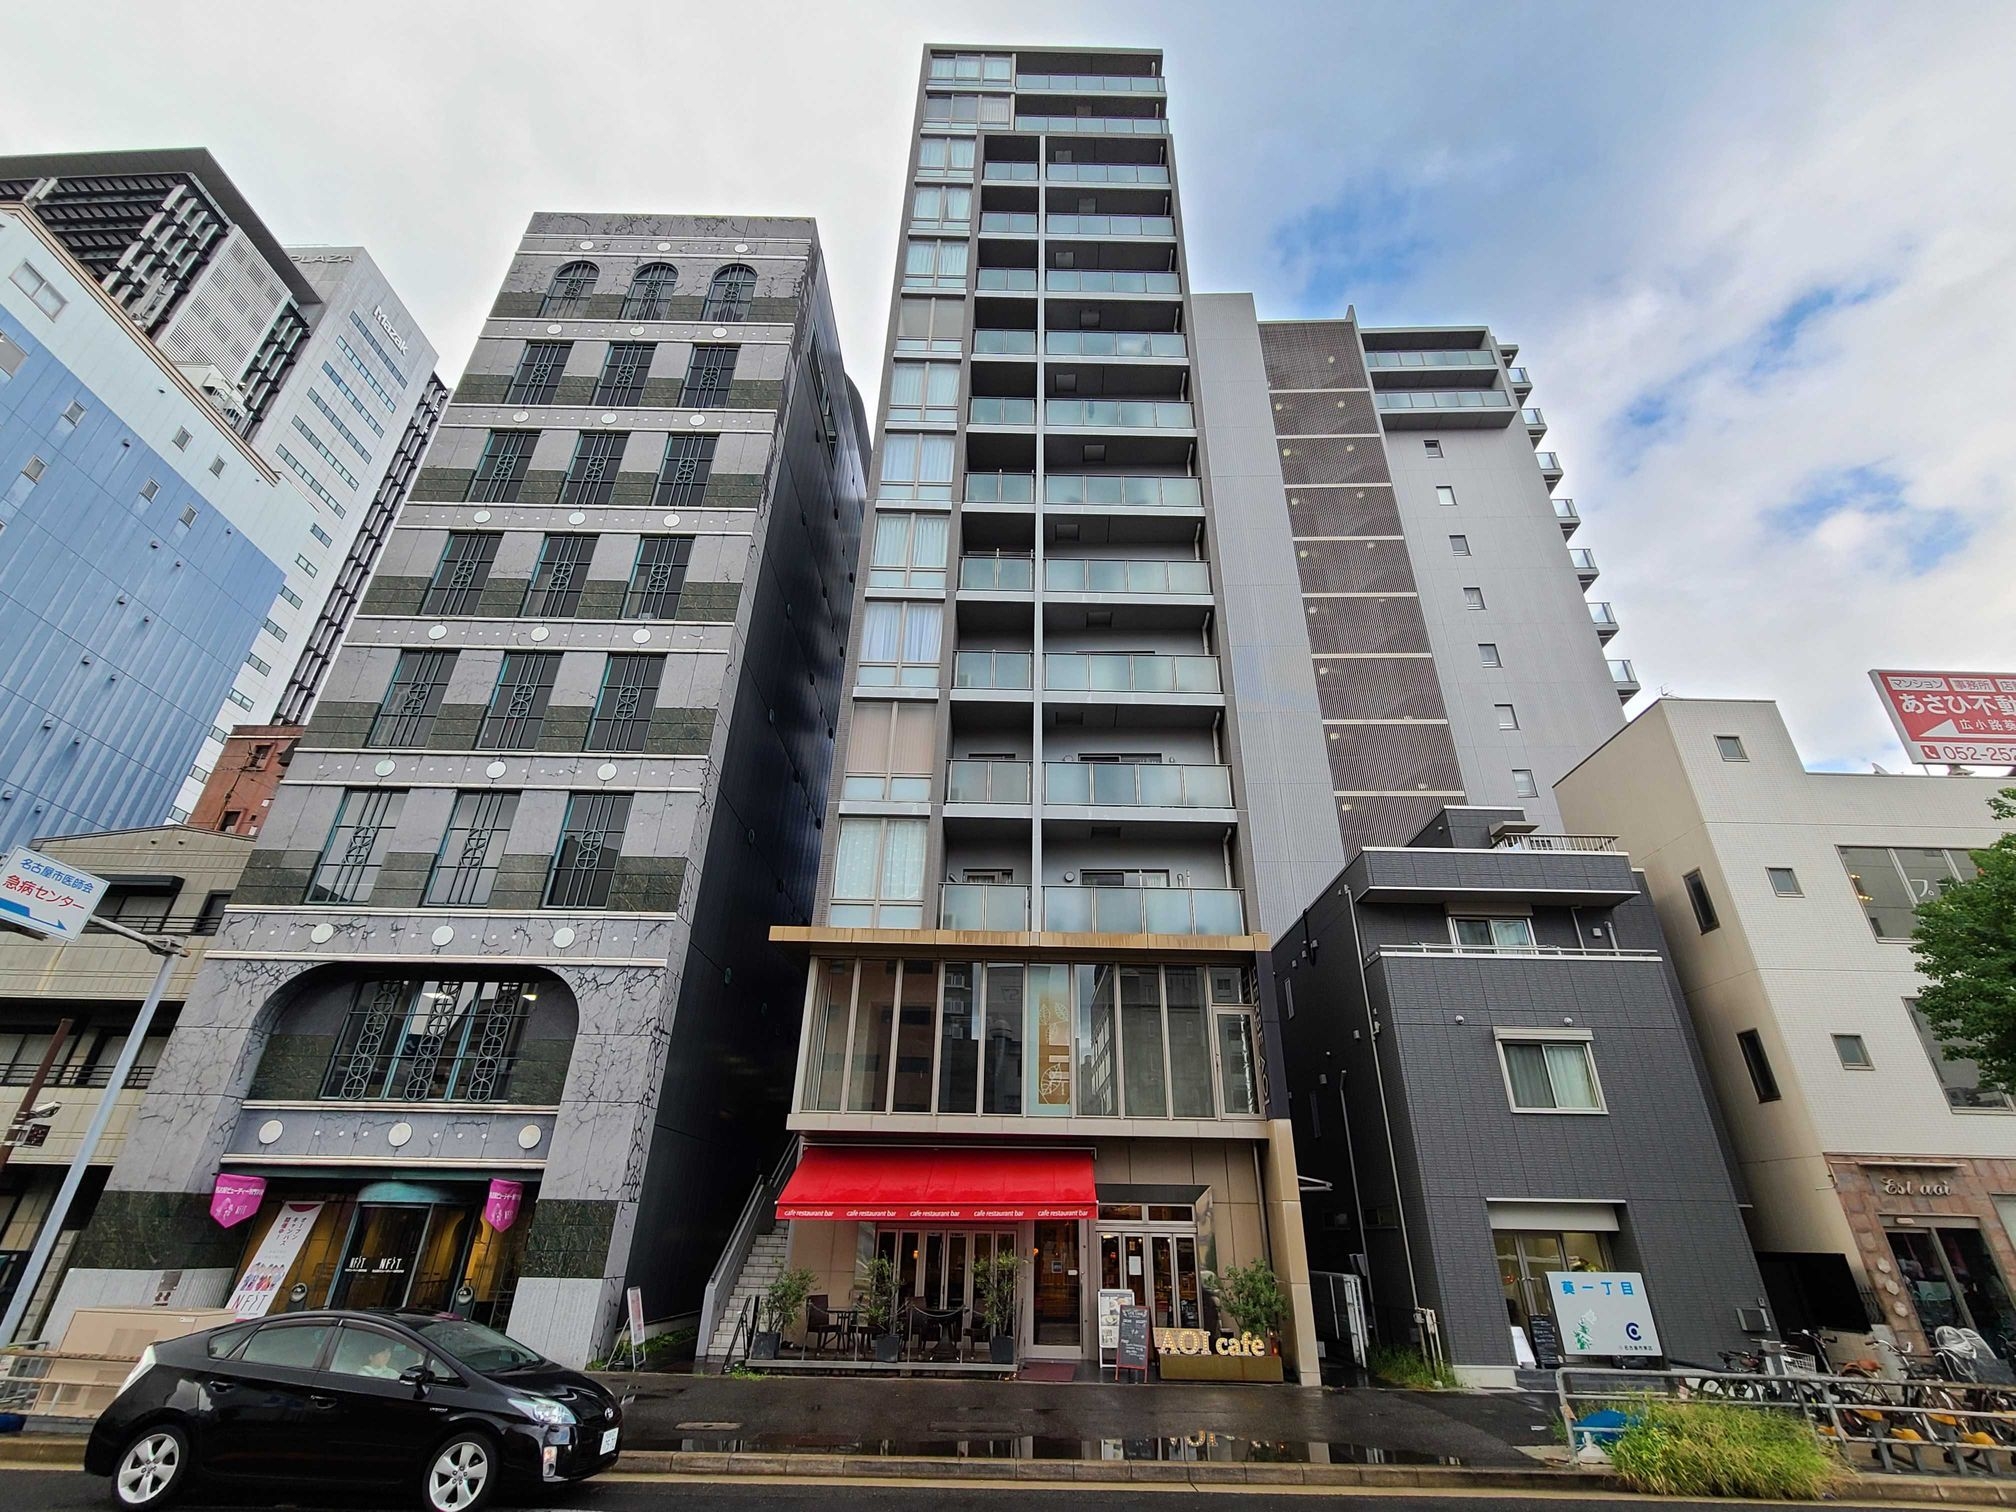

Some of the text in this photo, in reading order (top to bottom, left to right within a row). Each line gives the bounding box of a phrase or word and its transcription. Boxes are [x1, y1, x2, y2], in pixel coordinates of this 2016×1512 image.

[373, 304, 408, 356] Mazak
[1891, 679, 2016, 691] マンション 事務所 店
[1899, 693, 2016, 716] あさひ不動
[20, 858, 94, 894] 名古屋市医師会
[2, 874, 85, 909] 急病センター
[797, 1209, 823, 1217] restaurant
[824, 1209, 834, 1217] bar
[859, 1209, 886, 1217] restaurant
[887, 1209, 897, 1217] bar
[922, 1209, 949, 1217] restaurant
[950, 1209, 960, 1217] bar
[986, 1209, 1013, 1217] restaurant
[1014, 1209, 1024, 1217] bar
[1050, 1209, 1077, 1217] restaurant
[1079, 1209, 1088, 1217] bar
[1561, 1280, 1634, 1295] 葵一丁目
[1158, 1330, 1212, 1355] AOI
